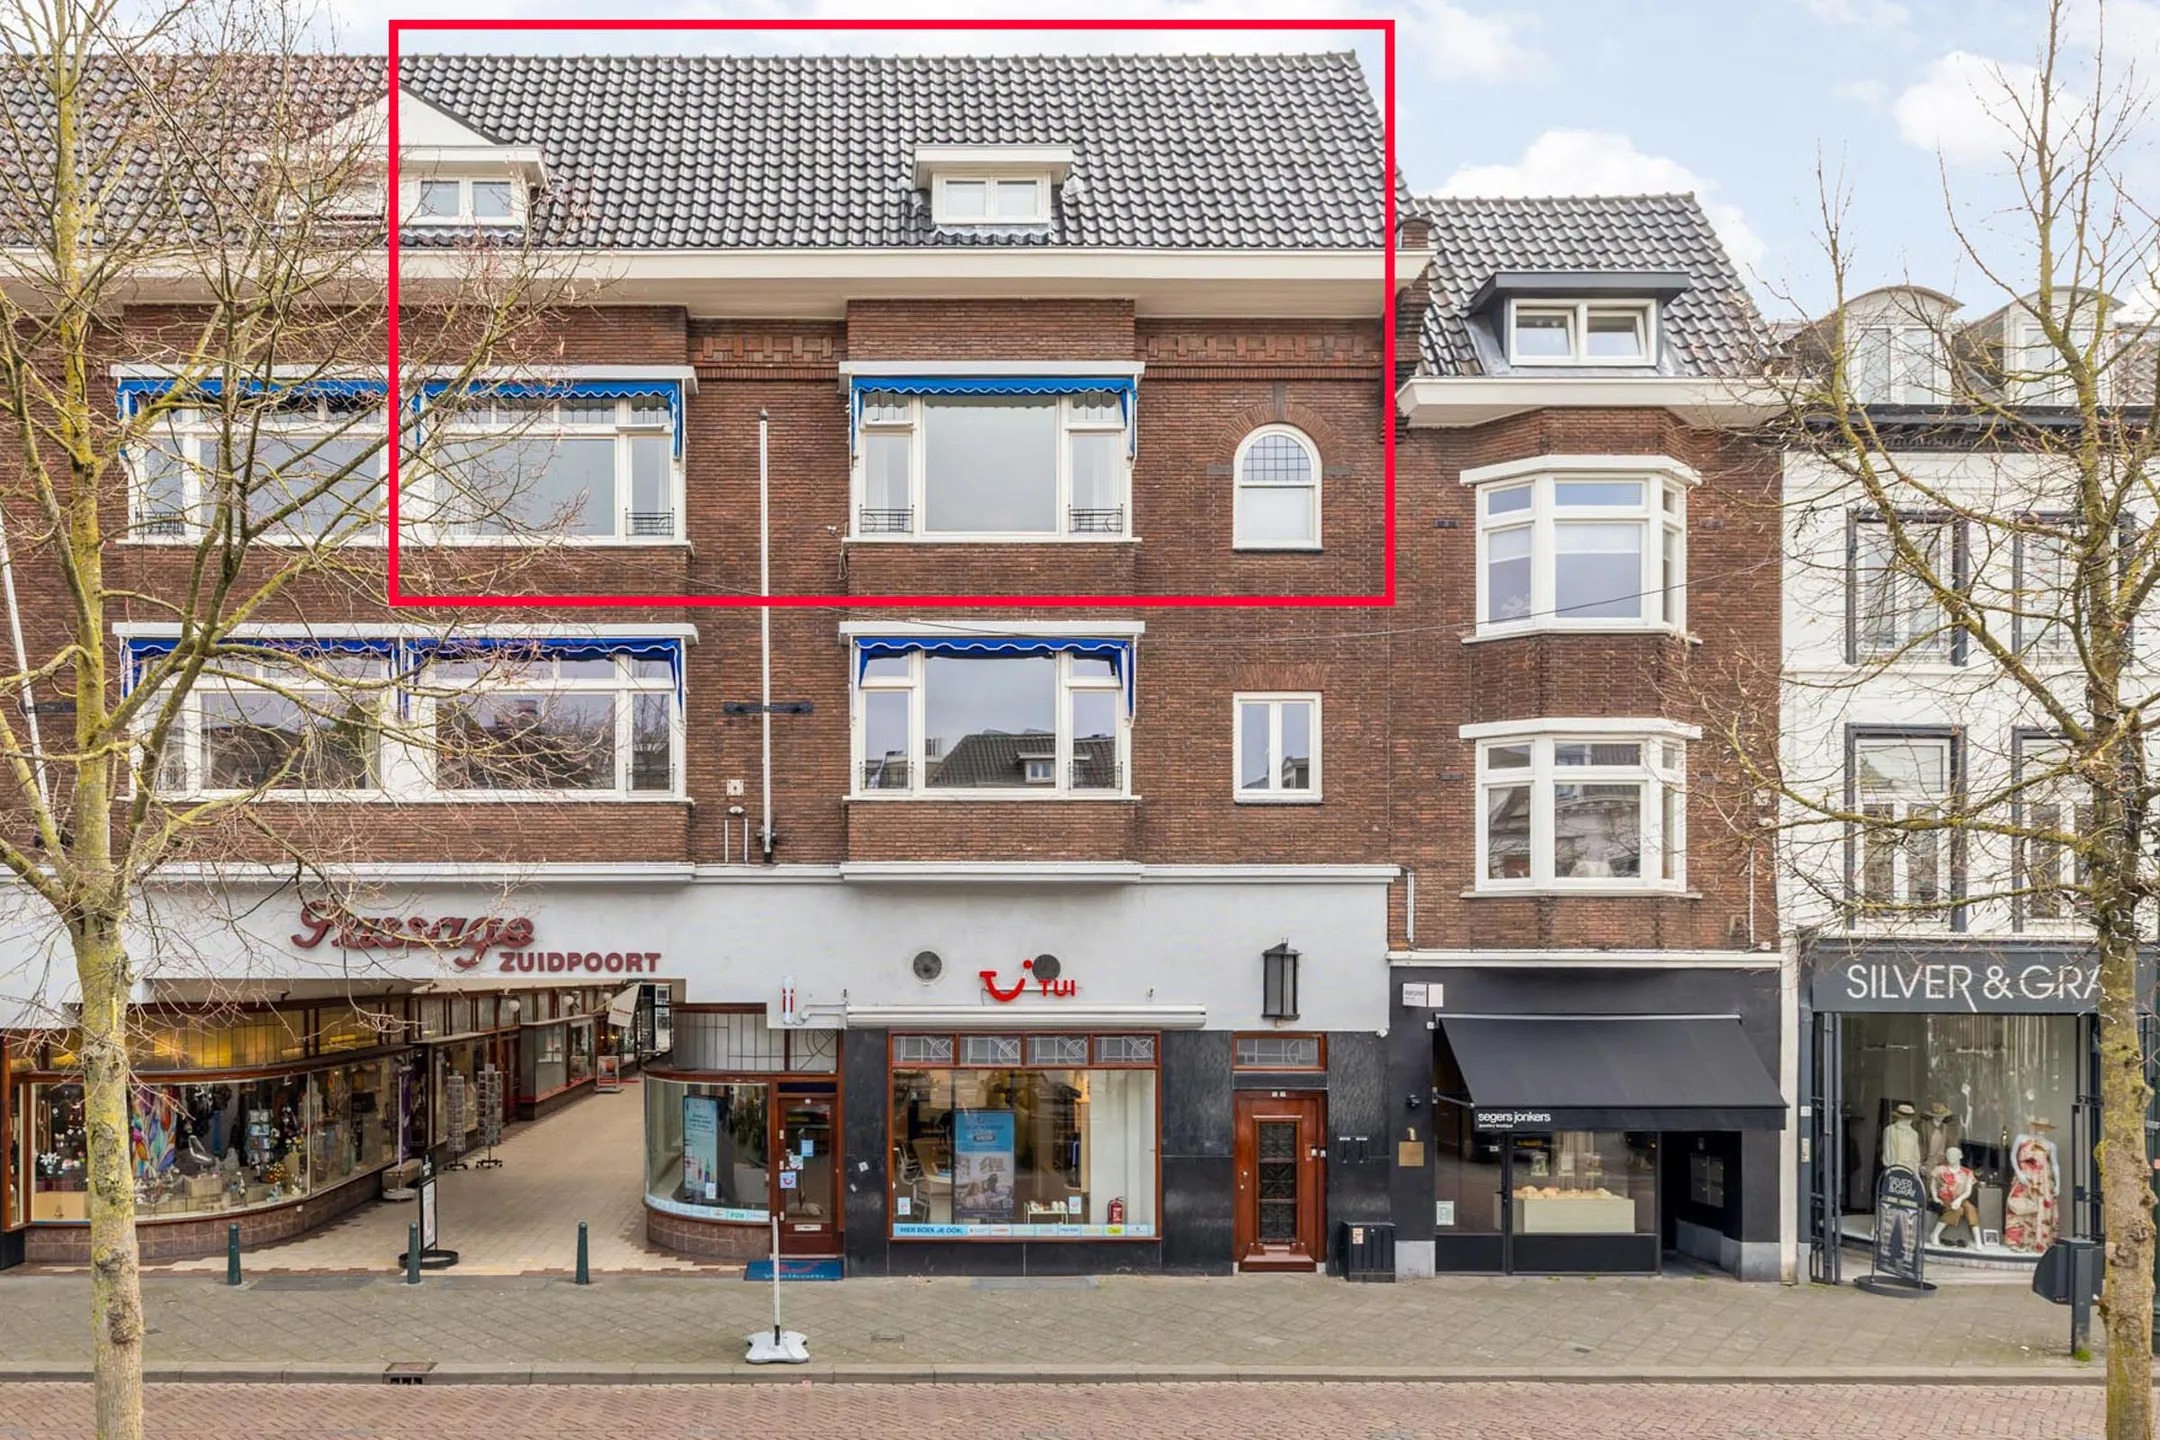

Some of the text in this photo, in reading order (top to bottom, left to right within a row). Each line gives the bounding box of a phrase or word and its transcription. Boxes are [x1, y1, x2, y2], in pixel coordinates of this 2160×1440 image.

[500, 952, 661, 972] ZUIDPOORT
[1038, 979, 1075, 996] TUI
[1847, 964, 2101, 1012] SILVER & GRA
[1478, 1111, 1551, 1123] segers jonkers
